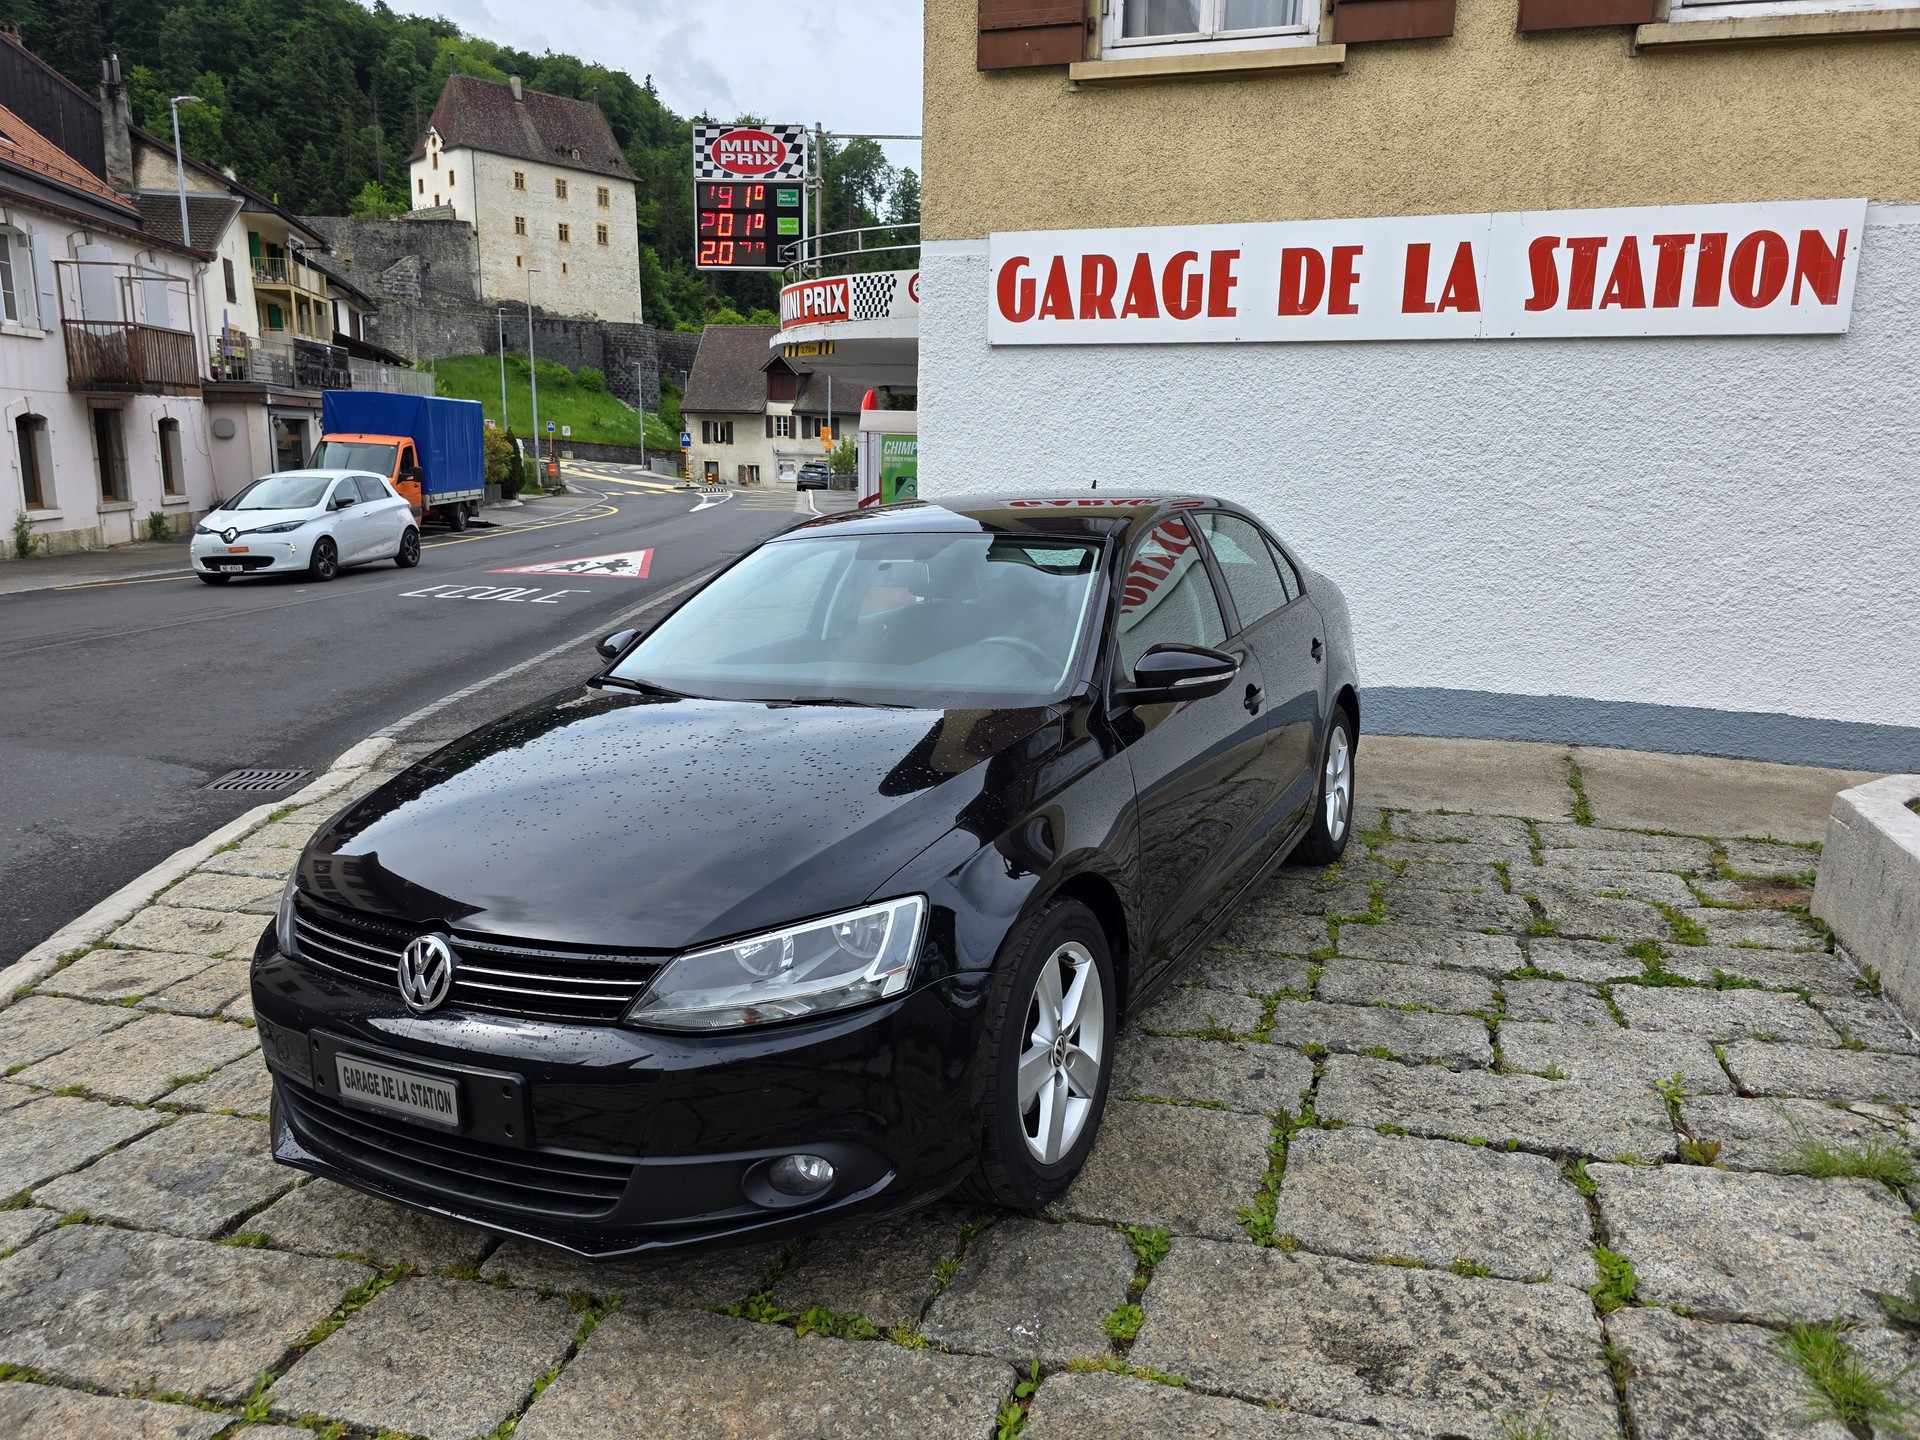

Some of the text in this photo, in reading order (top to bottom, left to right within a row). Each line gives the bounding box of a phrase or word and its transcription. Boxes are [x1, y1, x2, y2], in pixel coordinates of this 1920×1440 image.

[720, 139, 778, 152] MINI
[720, 153, 779, 166] PRIX
[996, 229, 1848, 324] GARAGE DE LA STATION
[803, 283, 846, 318] PRIX
[398, 584, 591, 604] ECOLE
[398, 935, 452, 1011] VW
[343, 1066, 453, 1115] GARAGE DE LA STATION
